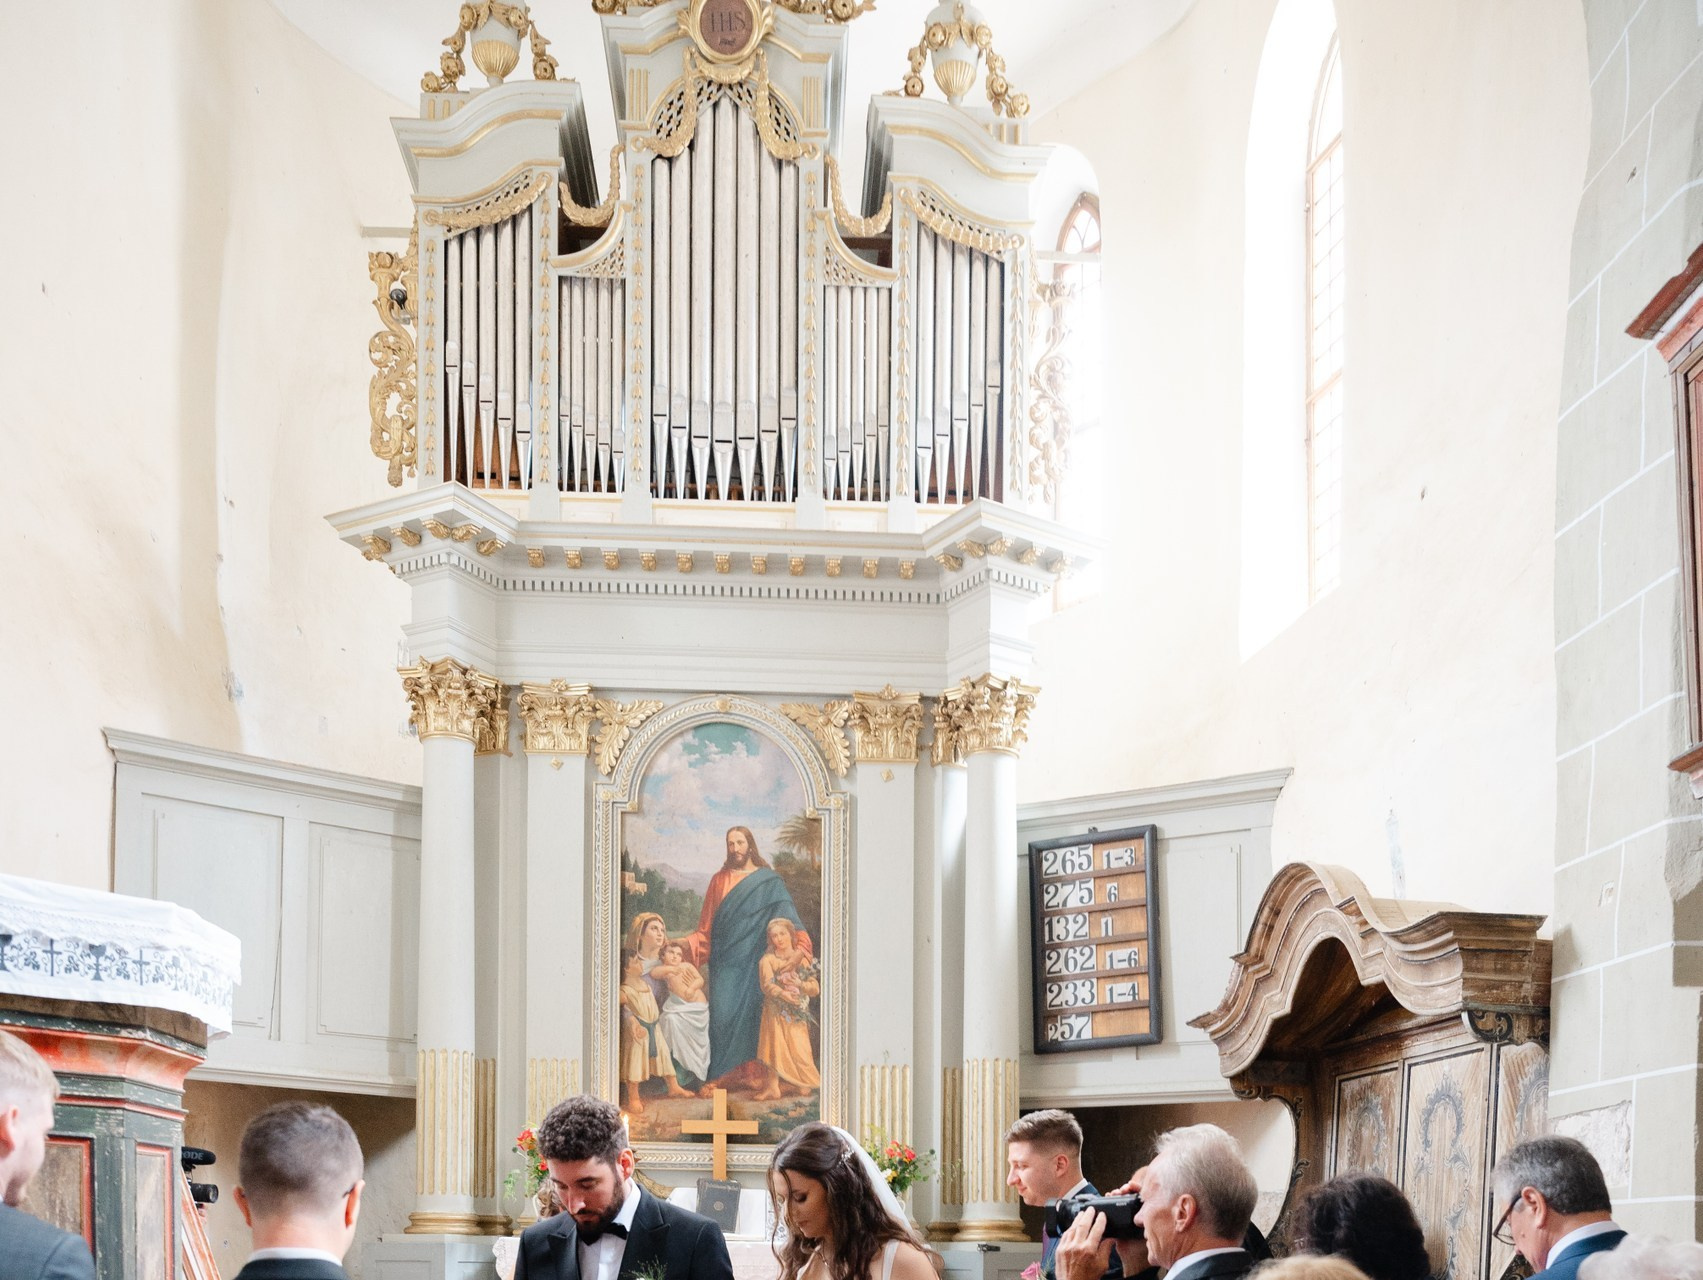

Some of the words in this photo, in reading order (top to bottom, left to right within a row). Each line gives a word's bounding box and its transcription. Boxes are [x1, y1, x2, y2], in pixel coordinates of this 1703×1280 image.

[1043, 845, 1092, 877] 265
[1104, 847, 1135, 869] 1-3
[1044, 879, 1093, 910] 275
[1107, 885, 1118, 903] 6
[1045, 912, 1088, 943] 132
[1103, 918, 1110, 937] 1
[1046, 945, 1095, 975] 262
[1107, 950, 1138, 970] 1-6
[1047, 979, 1096, 1008] 233
[1107, 982, 1139, 1003] 1-4
[1049, 1013, 1091, 1041] 257
